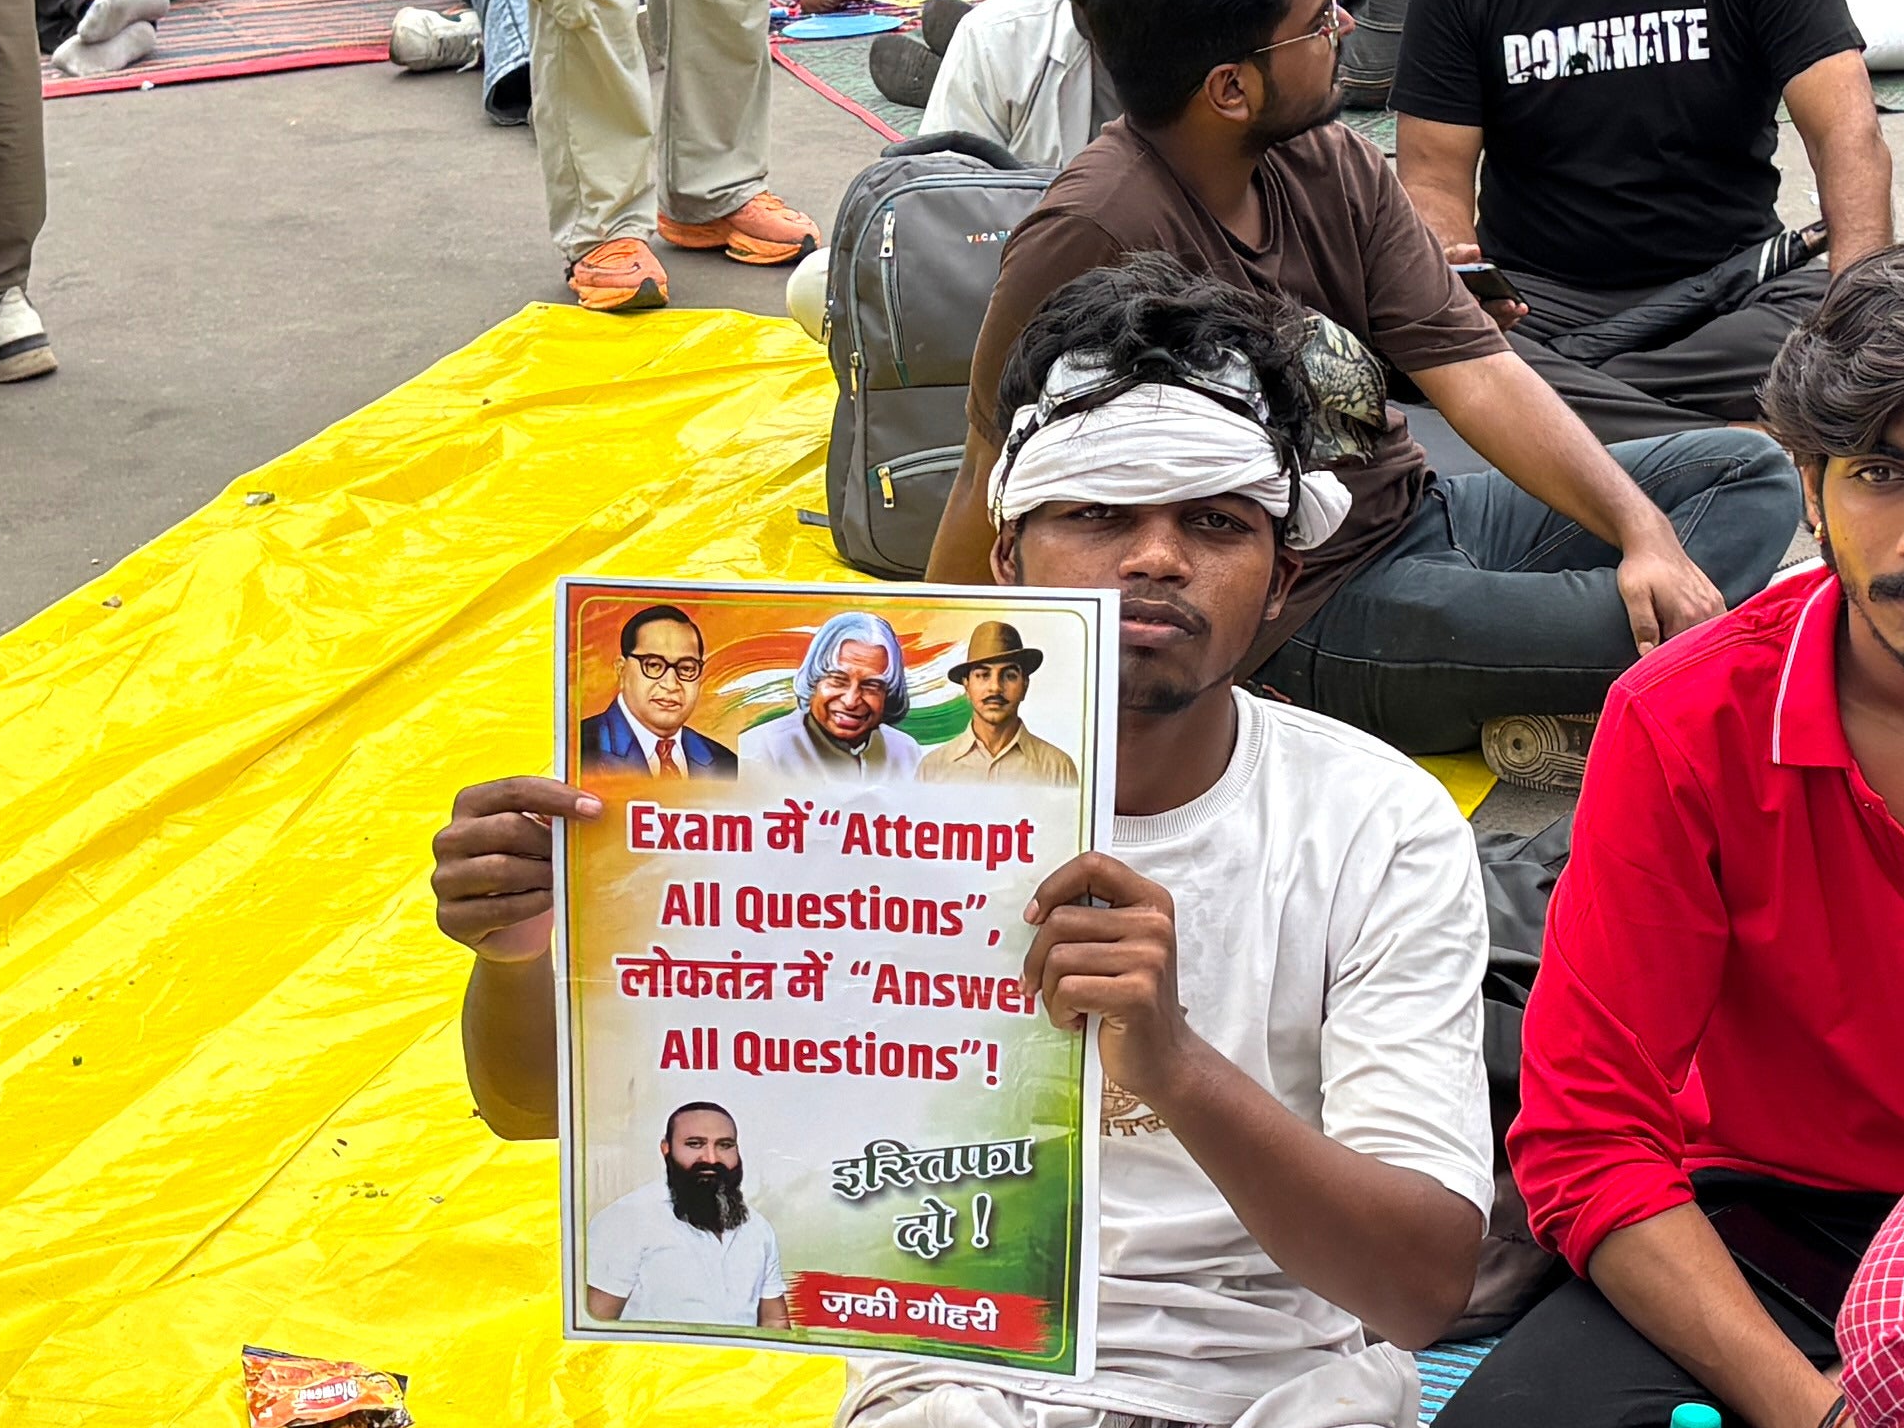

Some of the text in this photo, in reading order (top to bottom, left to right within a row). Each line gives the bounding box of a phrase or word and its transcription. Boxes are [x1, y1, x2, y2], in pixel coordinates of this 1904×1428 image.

[1502, 7, 1711, 85] DOMINATE
[630, 798, 1035, 871] Exam में “Attempt
[661, 881, 721, 927] All
[615, 945, 777, 1001] लोकतंत्र
[783, 950, 834, 1002] में
[659, 1027, 718, 1070] All
[906, 1291, 1000, 1332] गौहरी
